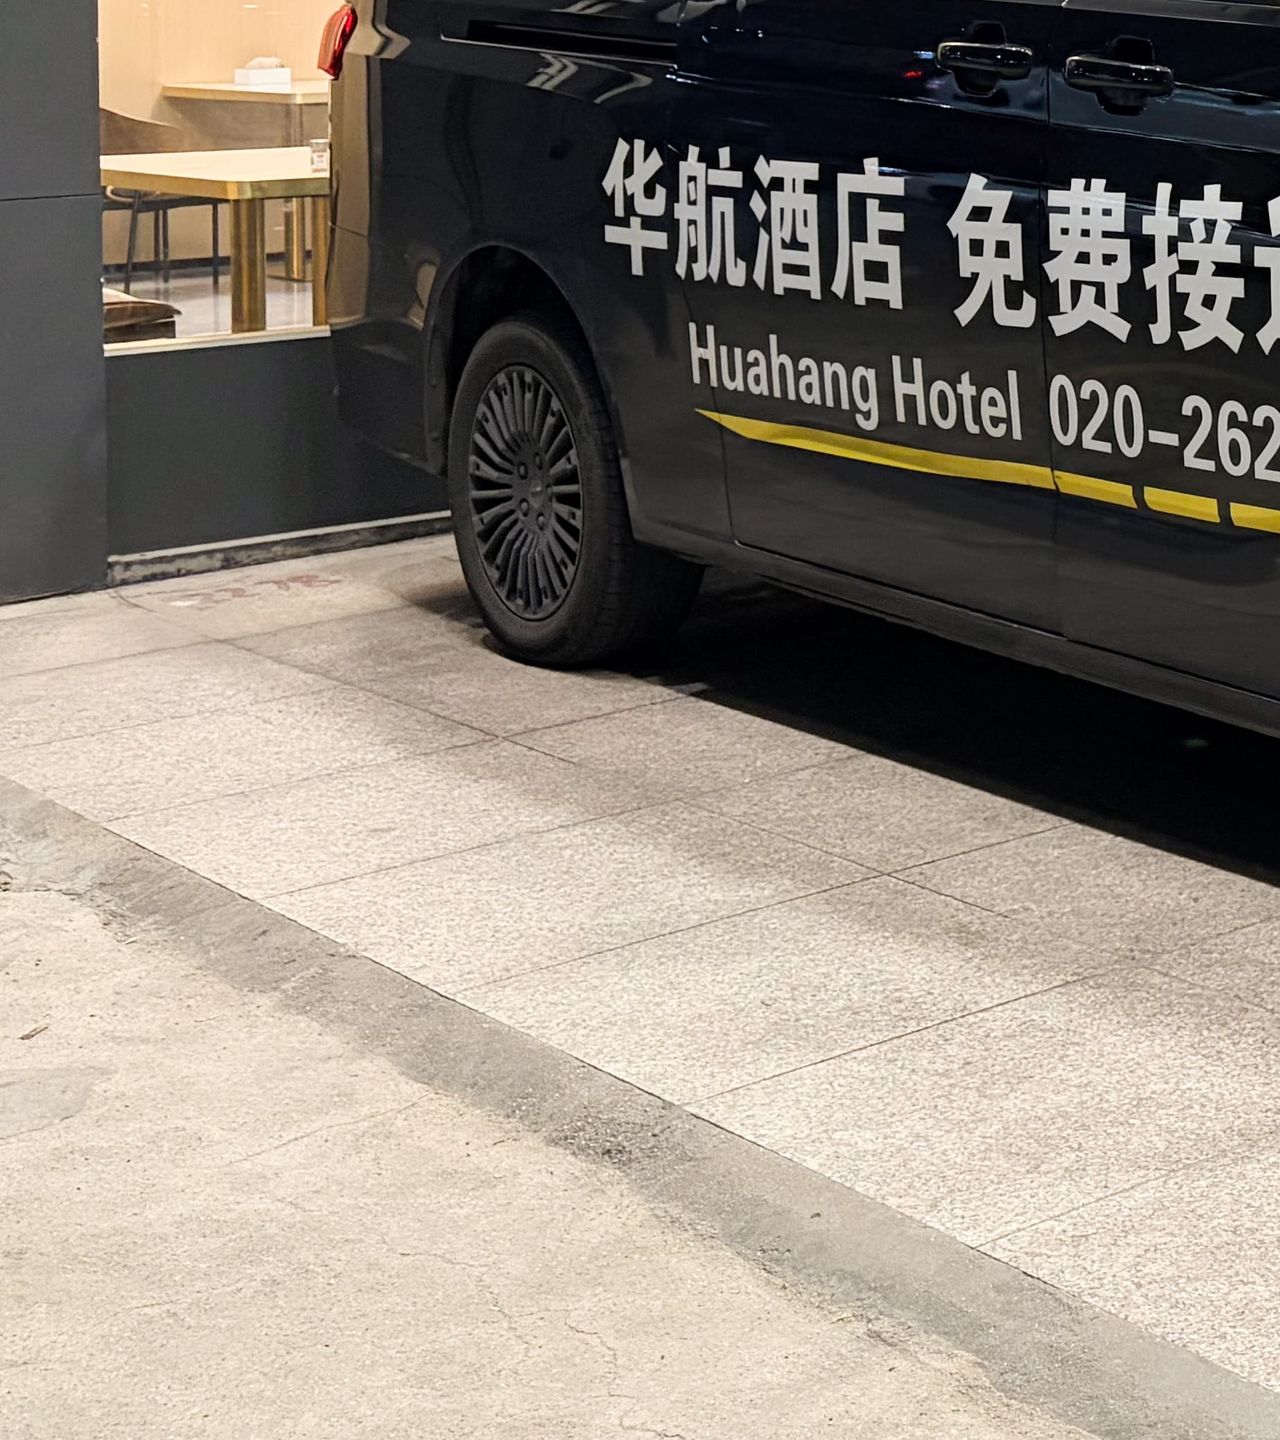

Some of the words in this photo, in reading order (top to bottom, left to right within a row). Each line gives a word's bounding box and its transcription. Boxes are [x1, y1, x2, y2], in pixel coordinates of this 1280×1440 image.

[602, 138, 906, 310] 华航酒店
[689, 323, 879, 432] Huahang
[892, 356, 1022, 441] Hotel
